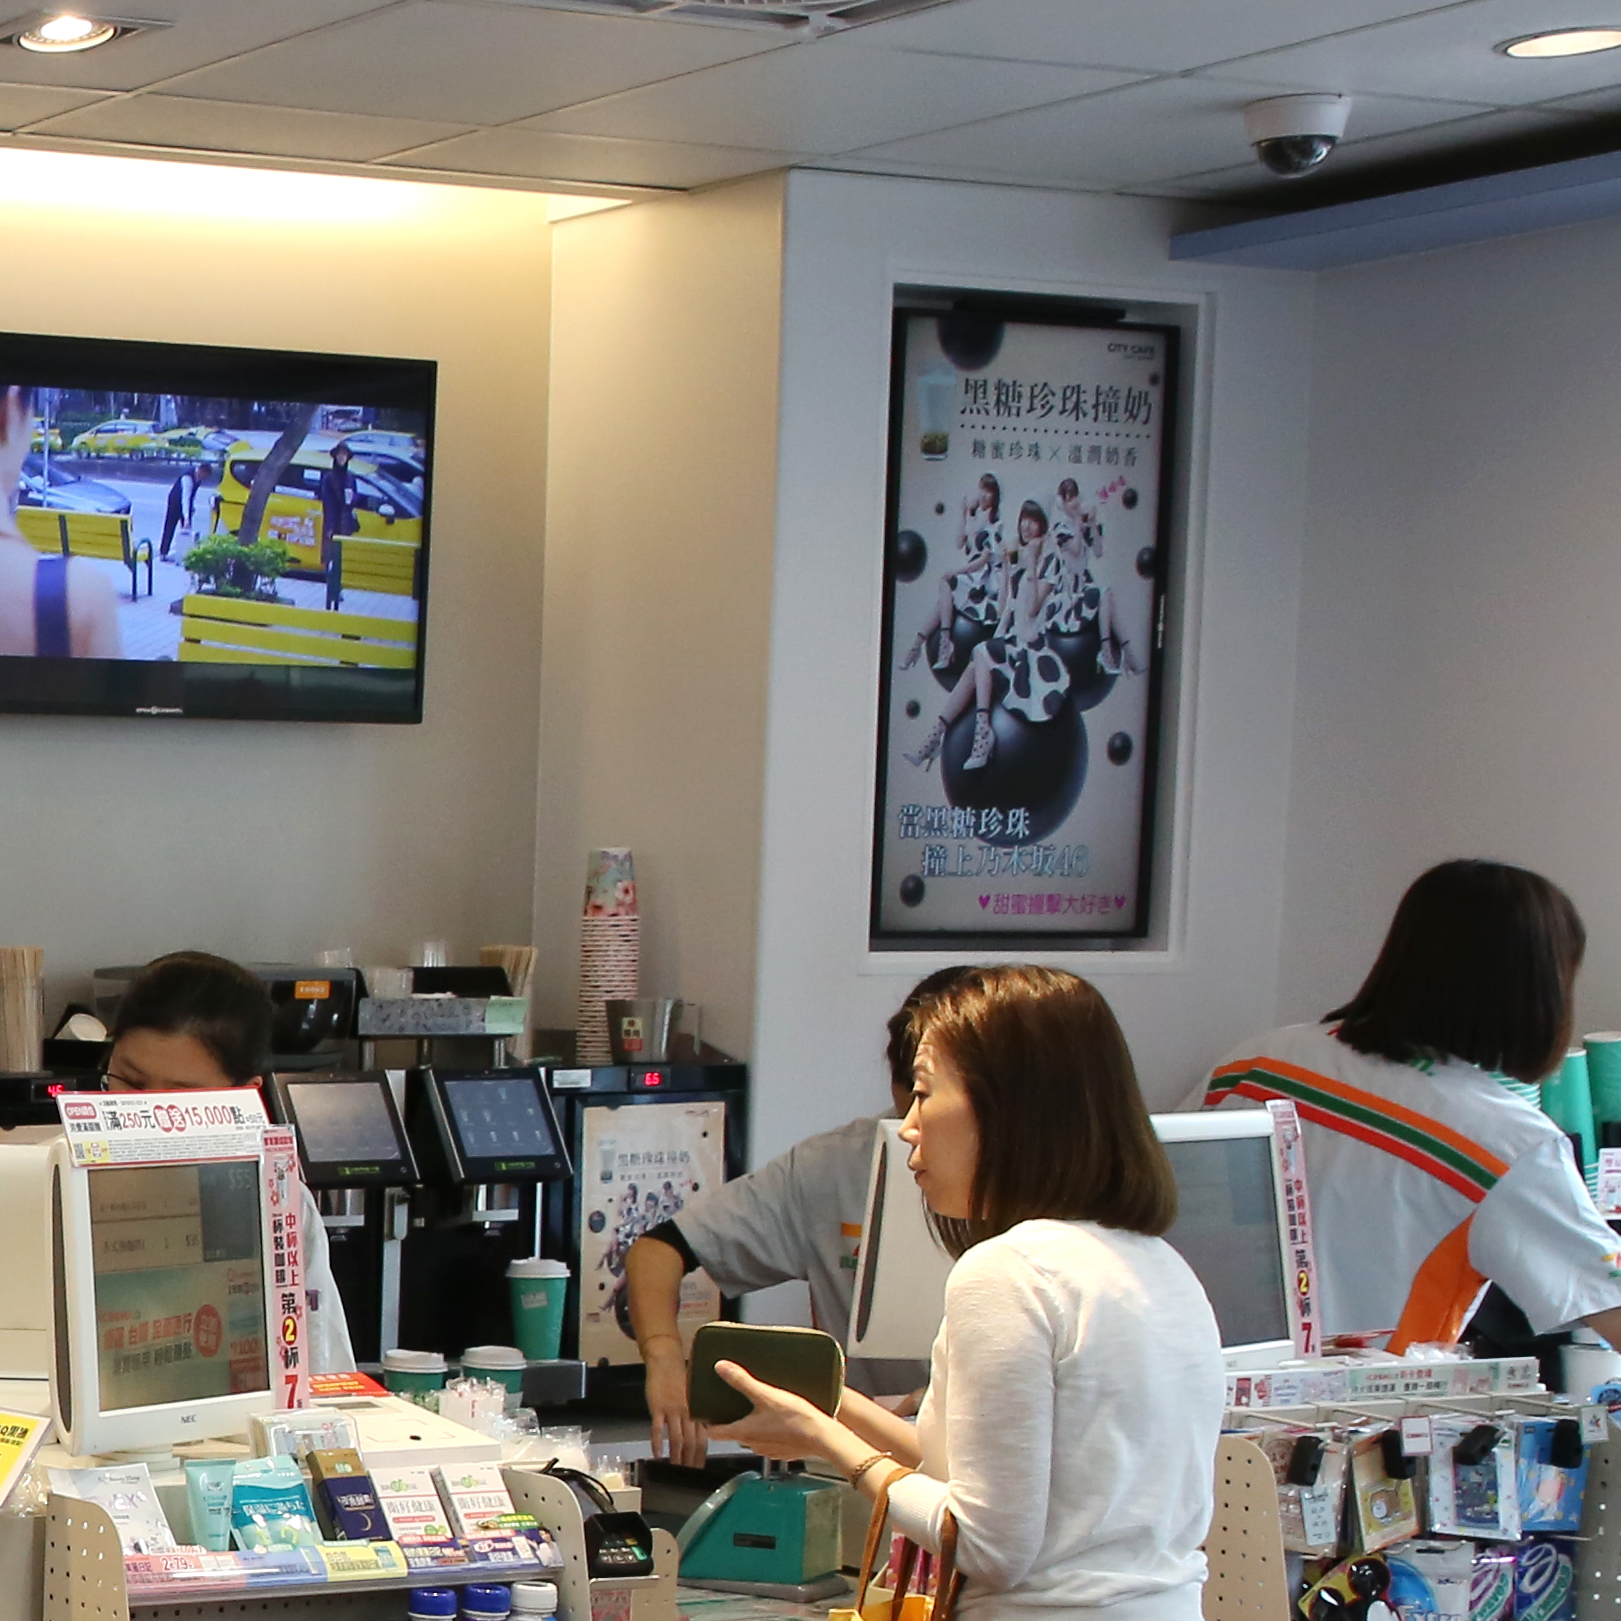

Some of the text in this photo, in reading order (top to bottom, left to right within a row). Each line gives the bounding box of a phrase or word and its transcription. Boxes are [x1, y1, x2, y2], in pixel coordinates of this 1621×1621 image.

[959, 377, 1154, 426] 黑糖珍珠撞奶
[897, 804, 1030, 840] 當黑糖珍珠
[922, 844, 1089, 878] 撞上乃木坂46
[180, 1415, 197, 1424] NEC
